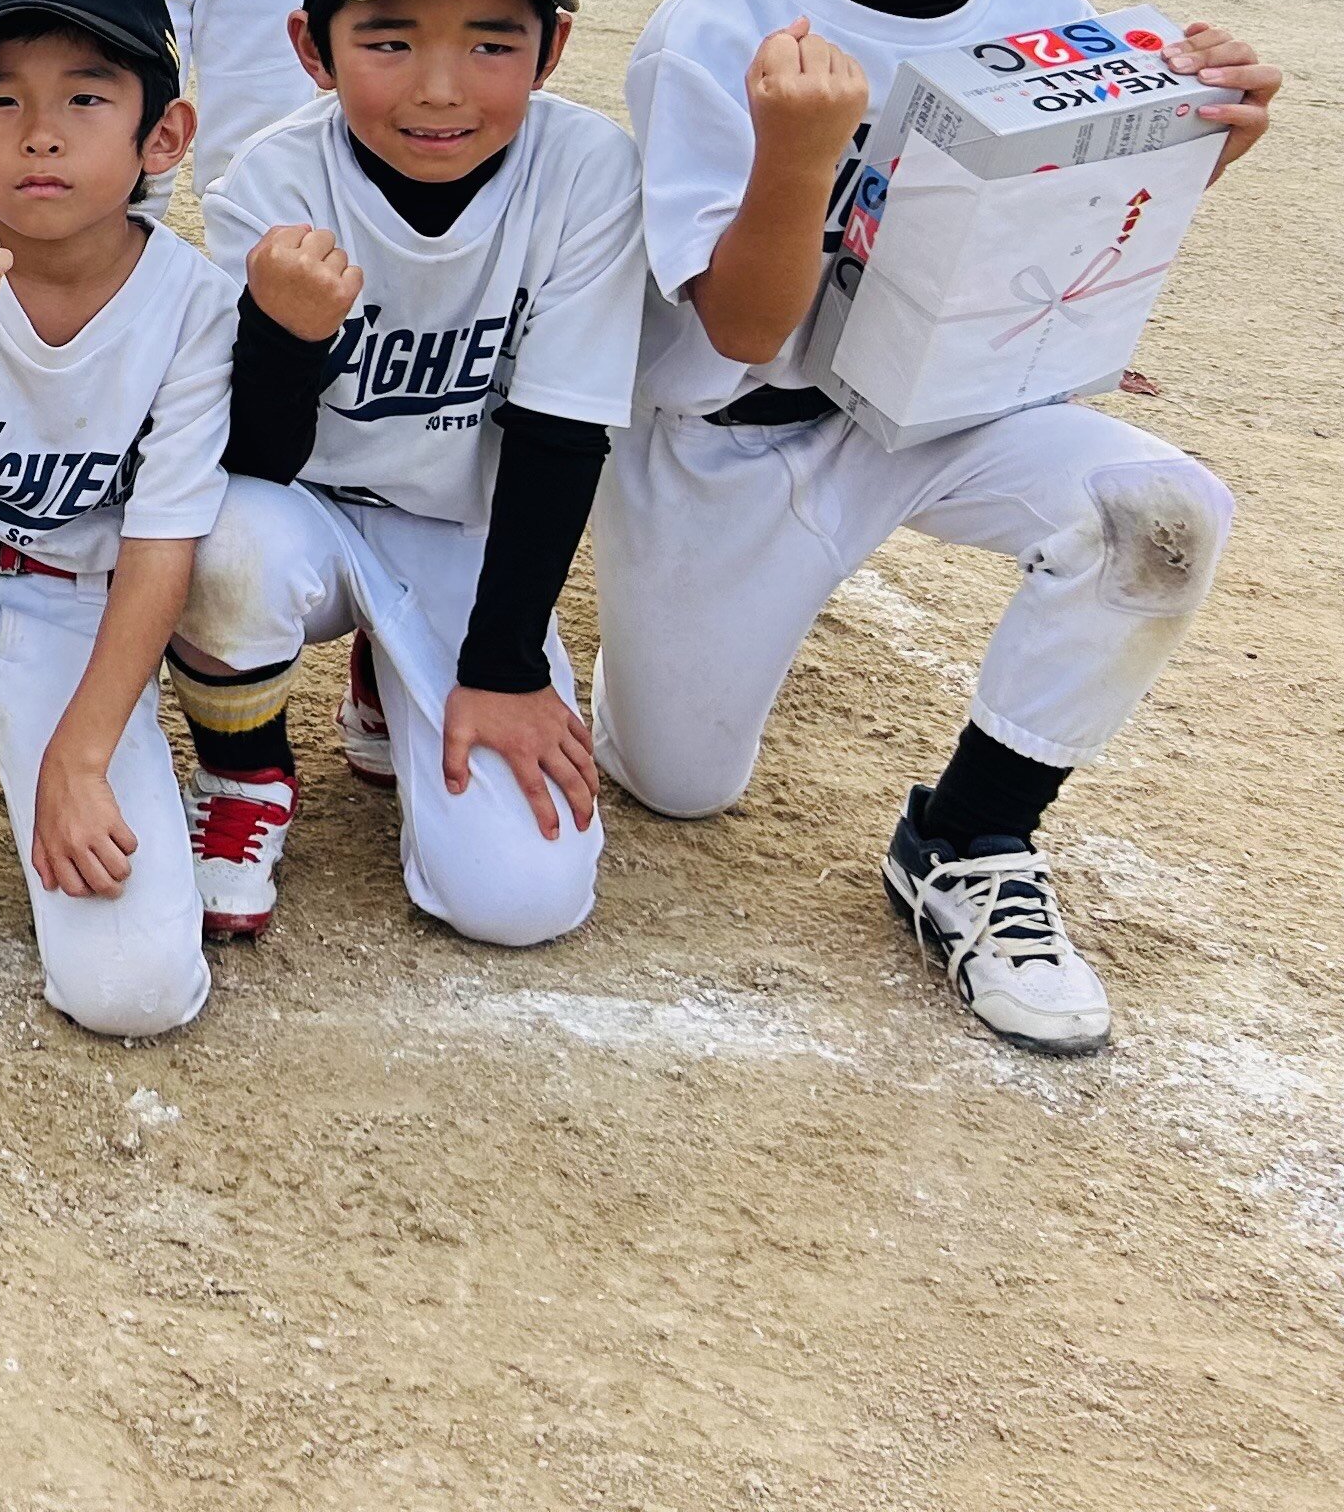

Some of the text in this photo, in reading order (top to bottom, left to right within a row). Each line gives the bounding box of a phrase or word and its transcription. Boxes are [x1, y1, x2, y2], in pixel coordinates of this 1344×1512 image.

[1023, 58, 1140, 91] BALL
[317, 284, 529, 406] FIGHE
[425, 410, 486, 432] OFTB
